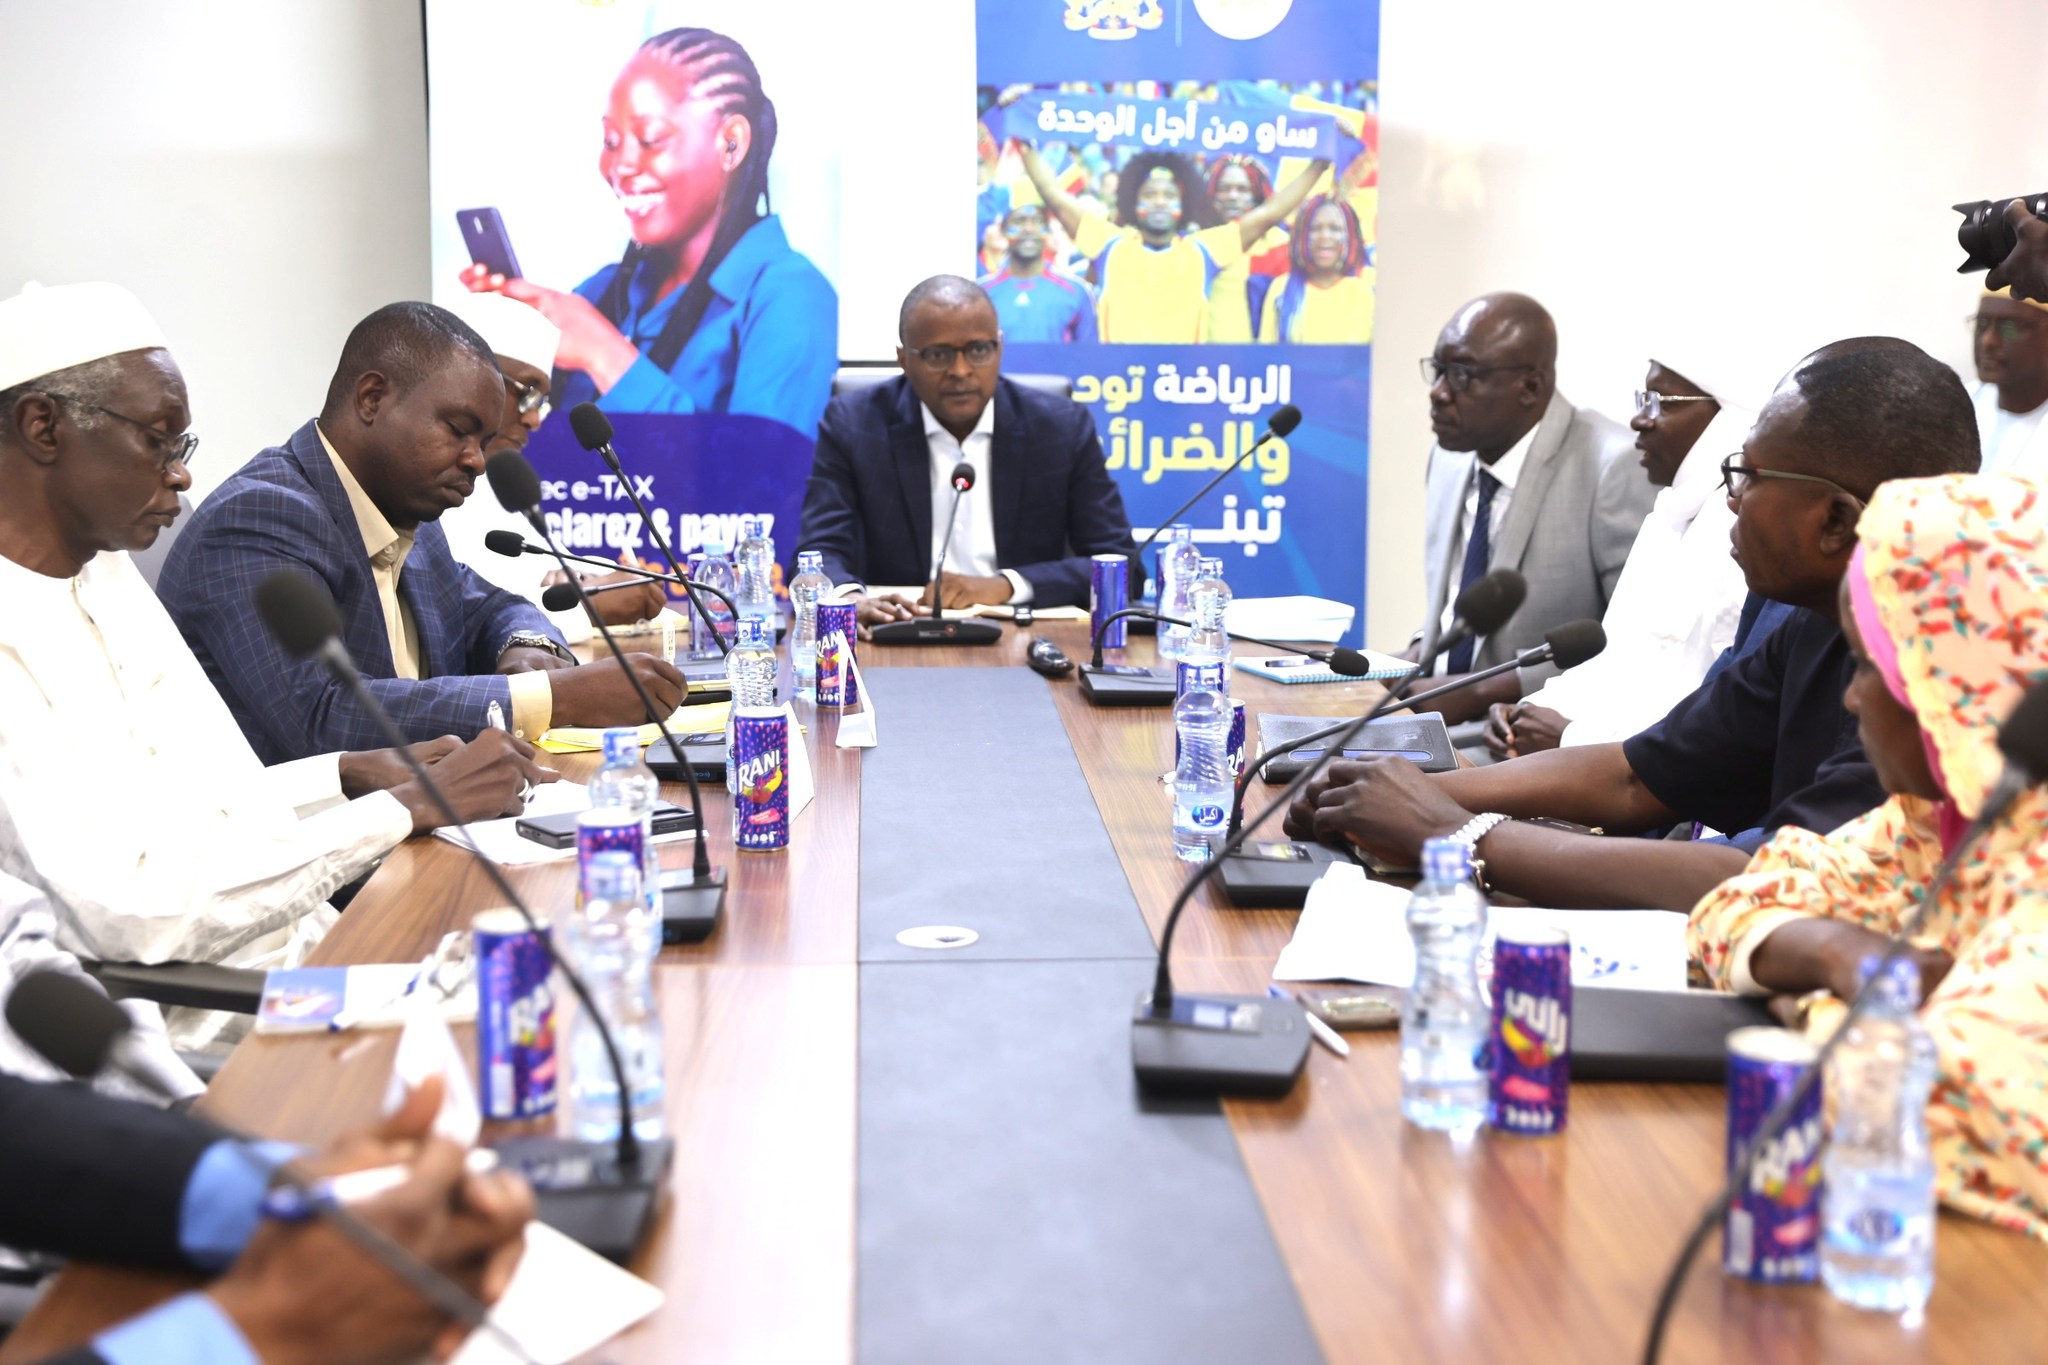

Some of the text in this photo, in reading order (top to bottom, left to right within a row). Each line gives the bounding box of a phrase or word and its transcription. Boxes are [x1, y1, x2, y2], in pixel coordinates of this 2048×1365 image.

[1037, 100, 1318, 154] ساو من أجل الوحدة
[1153, 363, 1292, 415] الرياضة
[570, 474, 655, 501] e-TAX
[648, 507, 673, 549] &
[738, 748, 780, 794] RANI
